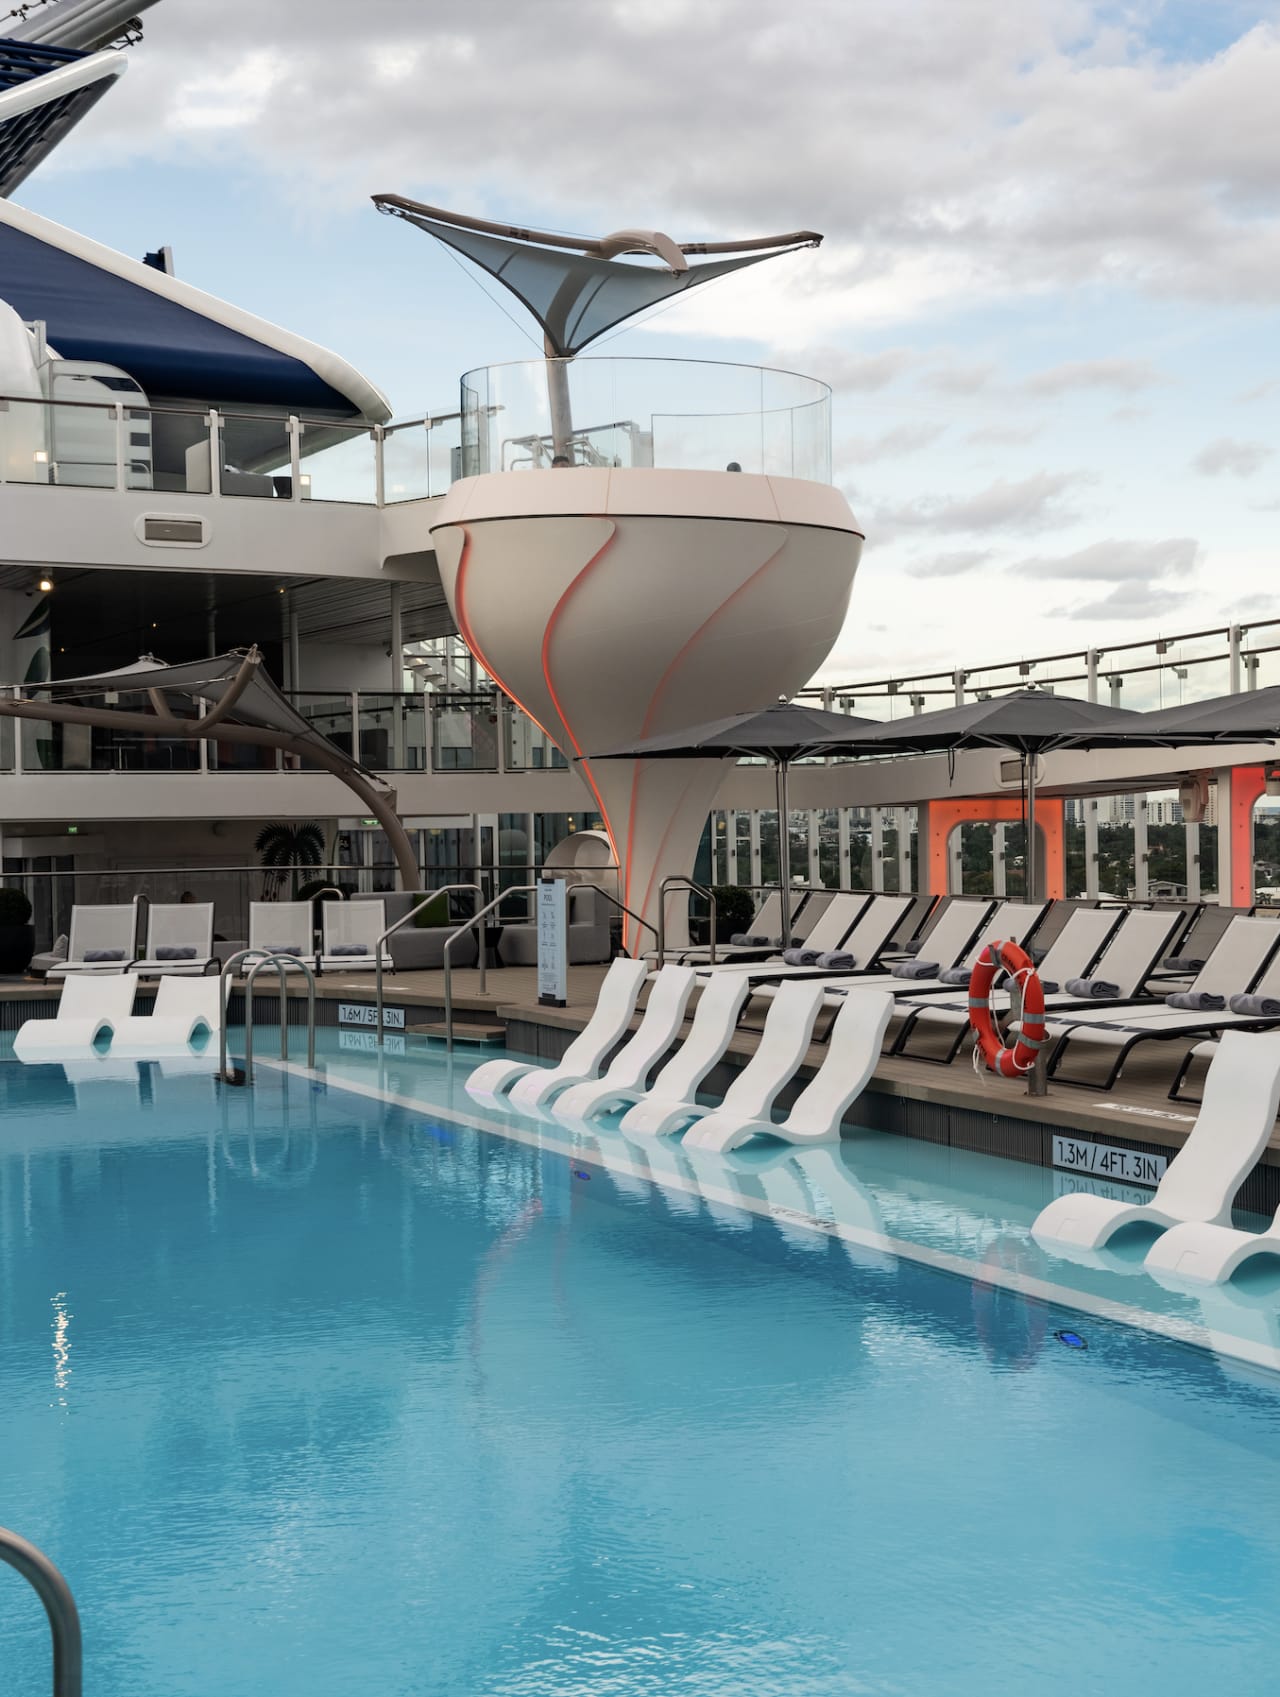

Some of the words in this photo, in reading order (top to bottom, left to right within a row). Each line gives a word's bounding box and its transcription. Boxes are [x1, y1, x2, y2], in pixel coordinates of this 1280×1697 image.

[342, 1007, 361, 1021] 1.6M
[386, 1011, 402, 1025] 3IN.
[1058, 1141, 1088, 1167] 1.3M
[1100, 1151, 1129, 1176] 4FT.
[1133, 1156, 1162, 1182] 3IN.
